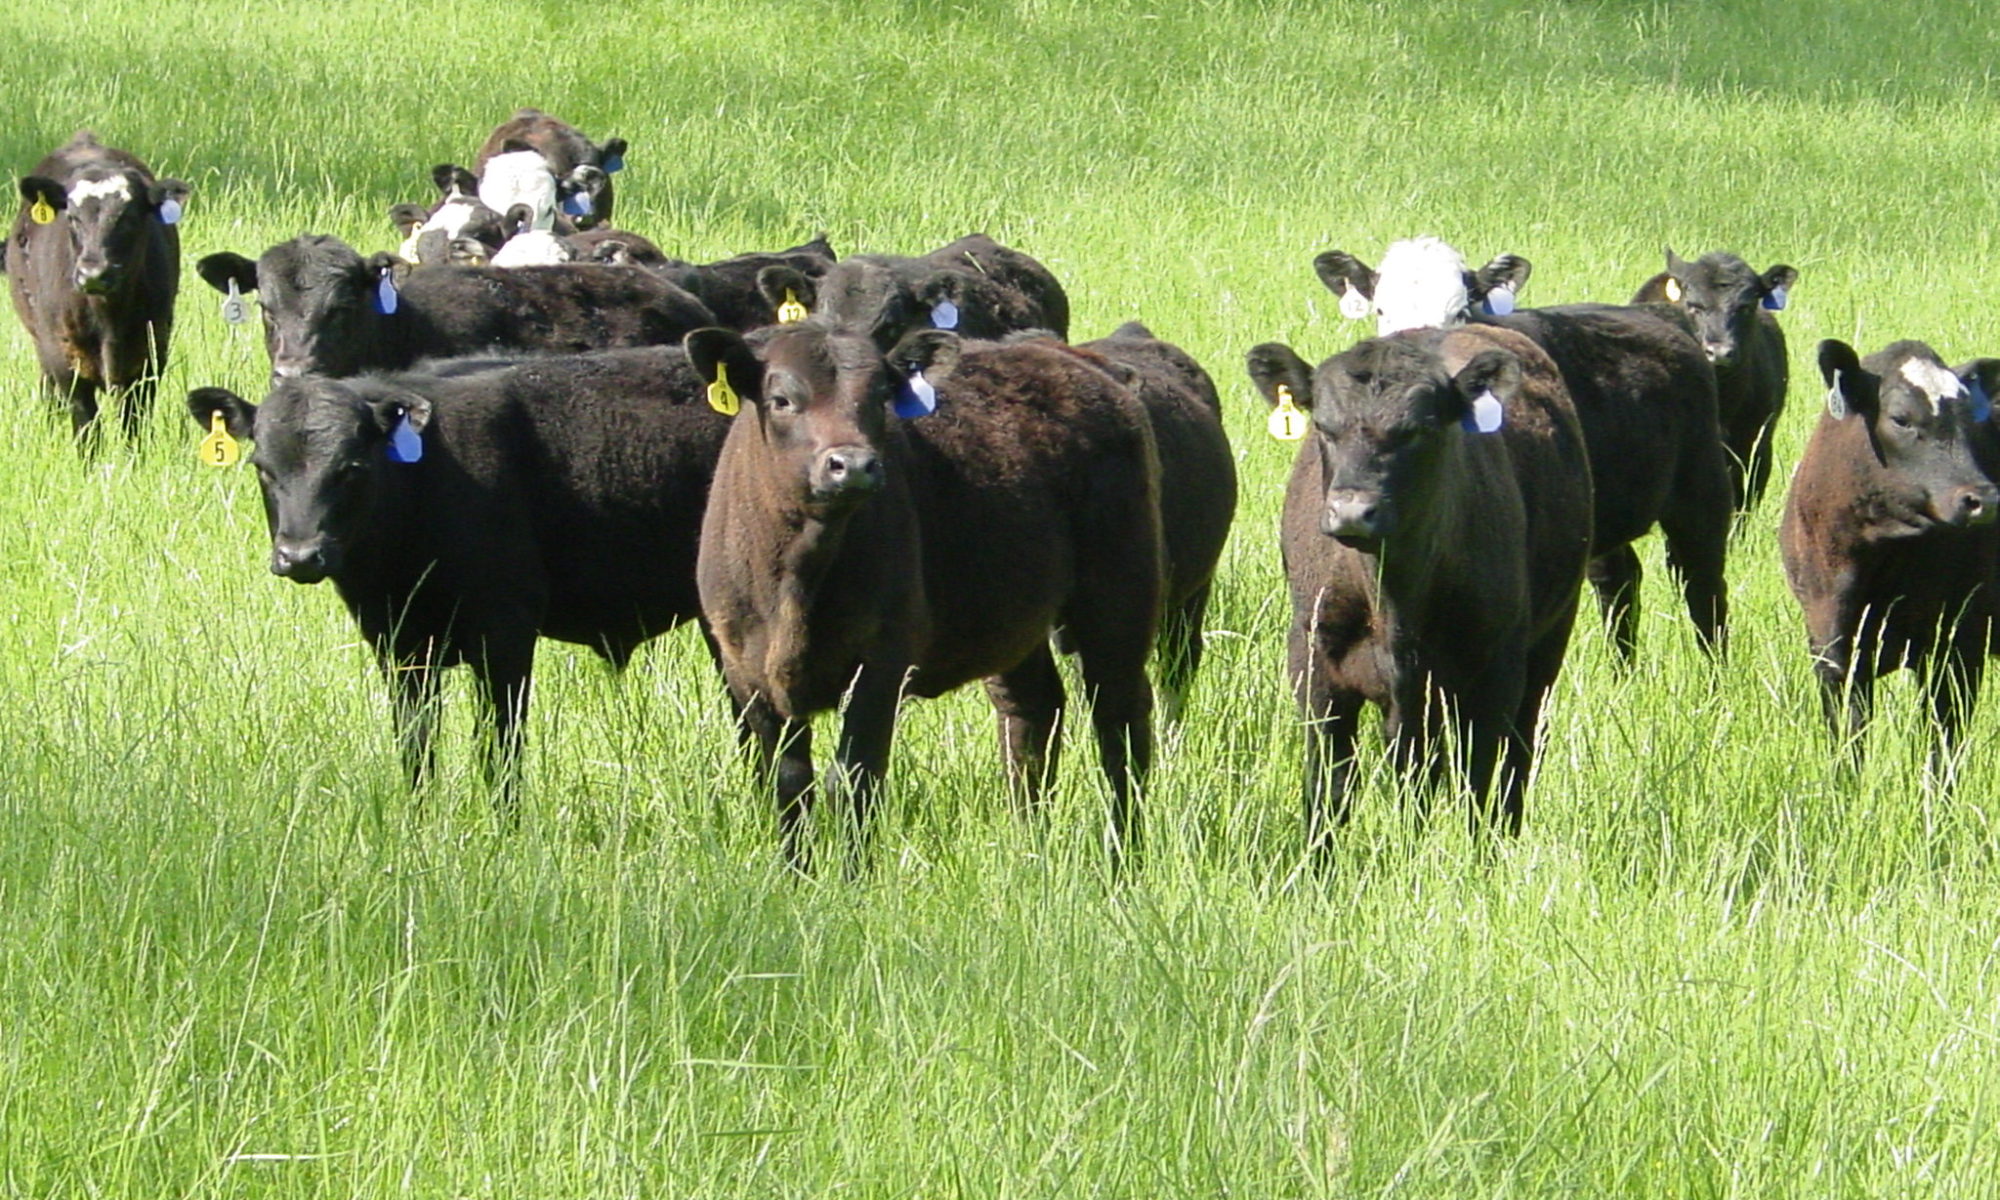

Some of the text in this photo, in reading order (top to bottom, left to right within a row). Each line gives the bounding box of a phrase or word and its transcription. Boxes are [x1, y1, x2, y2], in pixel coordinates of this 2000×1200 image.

[230, 302, 242, 321] 3
[1347, 299, 1364, 312] 12
[720, 390, 729, 411] 4
[1284, 415, 1292, 436] 1
[215, 441, 225, 463] 5
